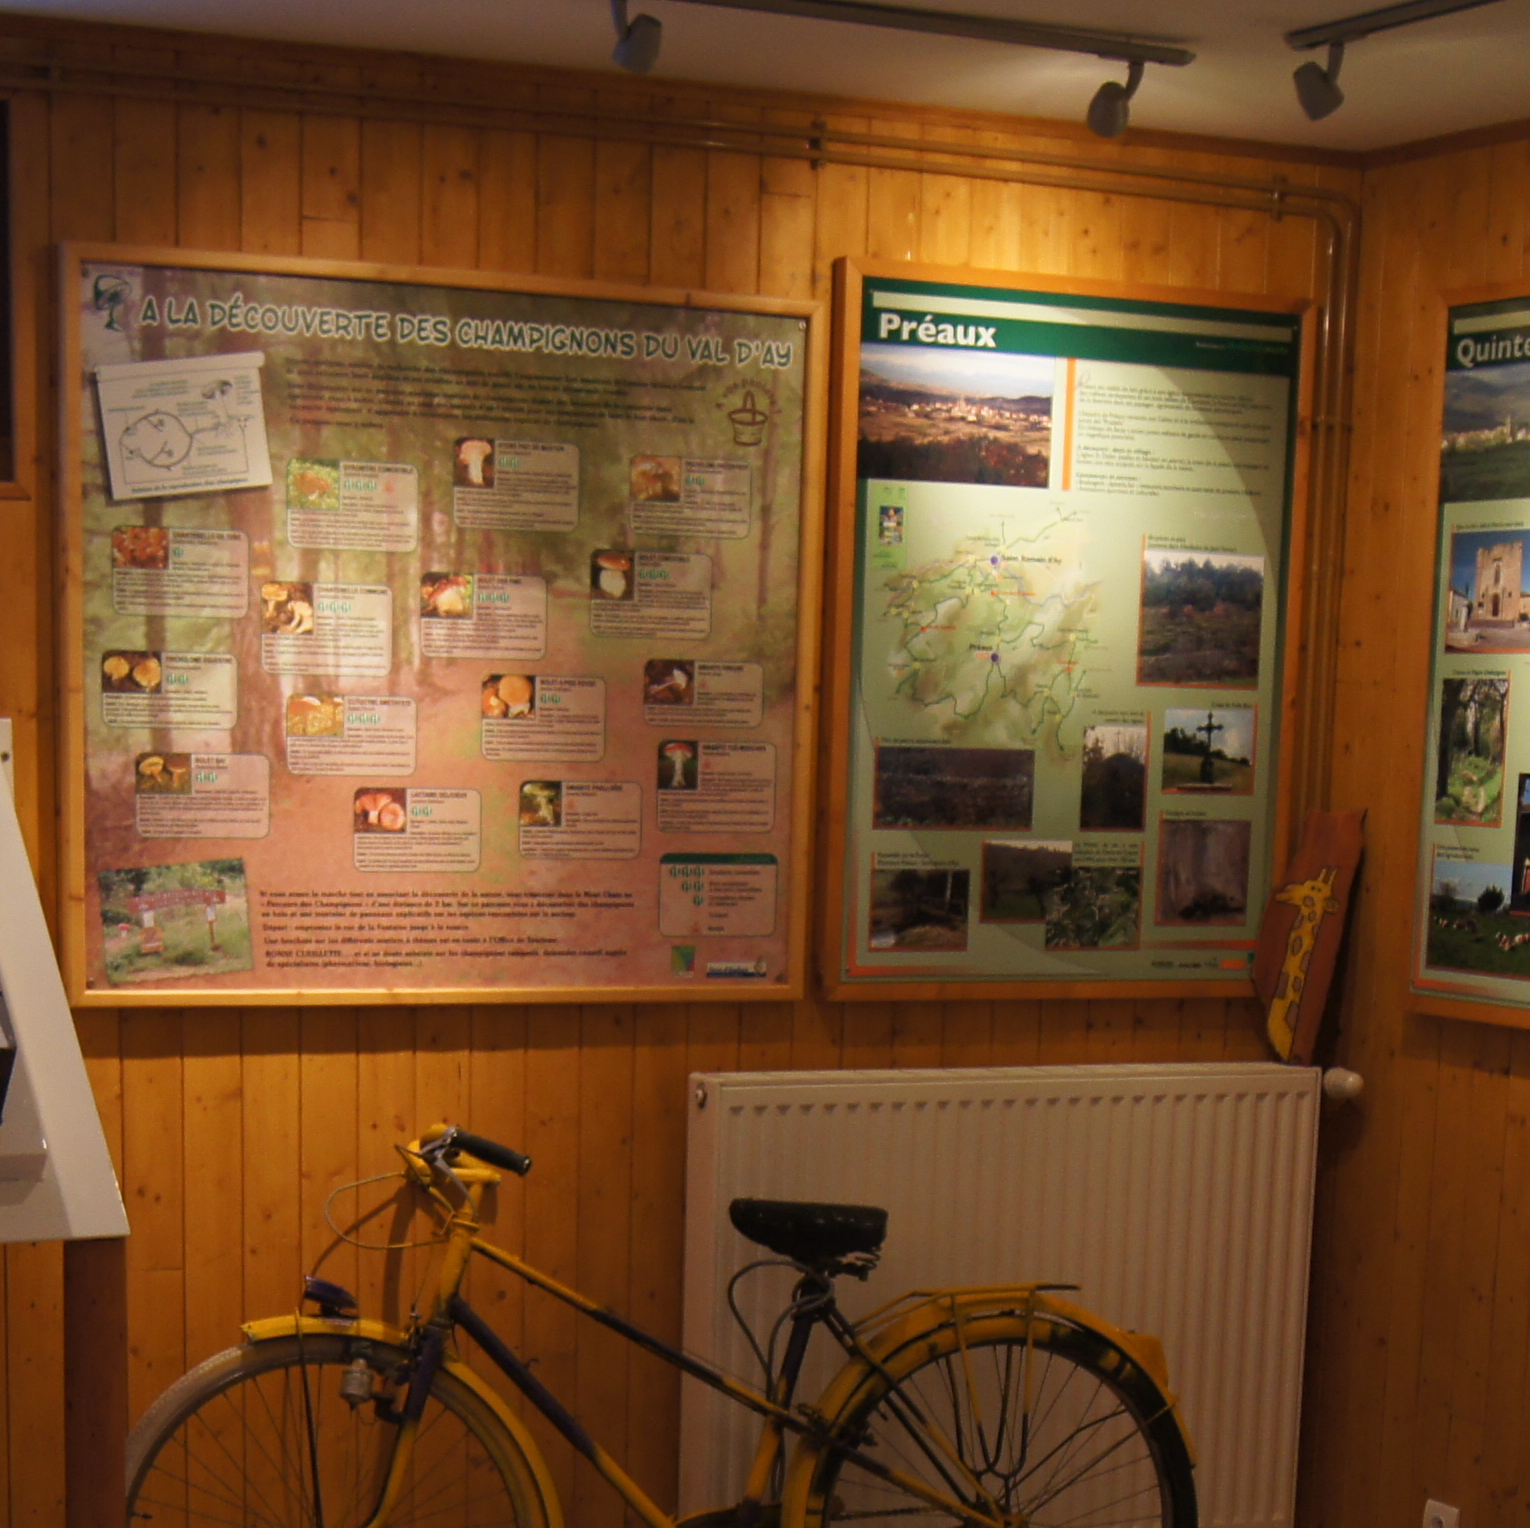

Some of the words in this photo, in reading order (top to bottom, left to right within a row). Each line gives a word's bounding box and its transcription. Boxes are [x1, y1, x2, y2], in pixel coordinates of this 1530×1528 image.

[141, 297, 159, 326] A
[166, 297, 201, 327] LA
[207, 291, 391, 340] DÉCOUVERTE
[398, 313, 451, 346] DES
[456, 318, 638, 361] CHAMPIGNONS
[643, 332, 679, 360] DU
[686, 334, 729, 365] VAL
[734, 339, 794, 370] D'AY
[877, 312, 997, 349] Préaux
